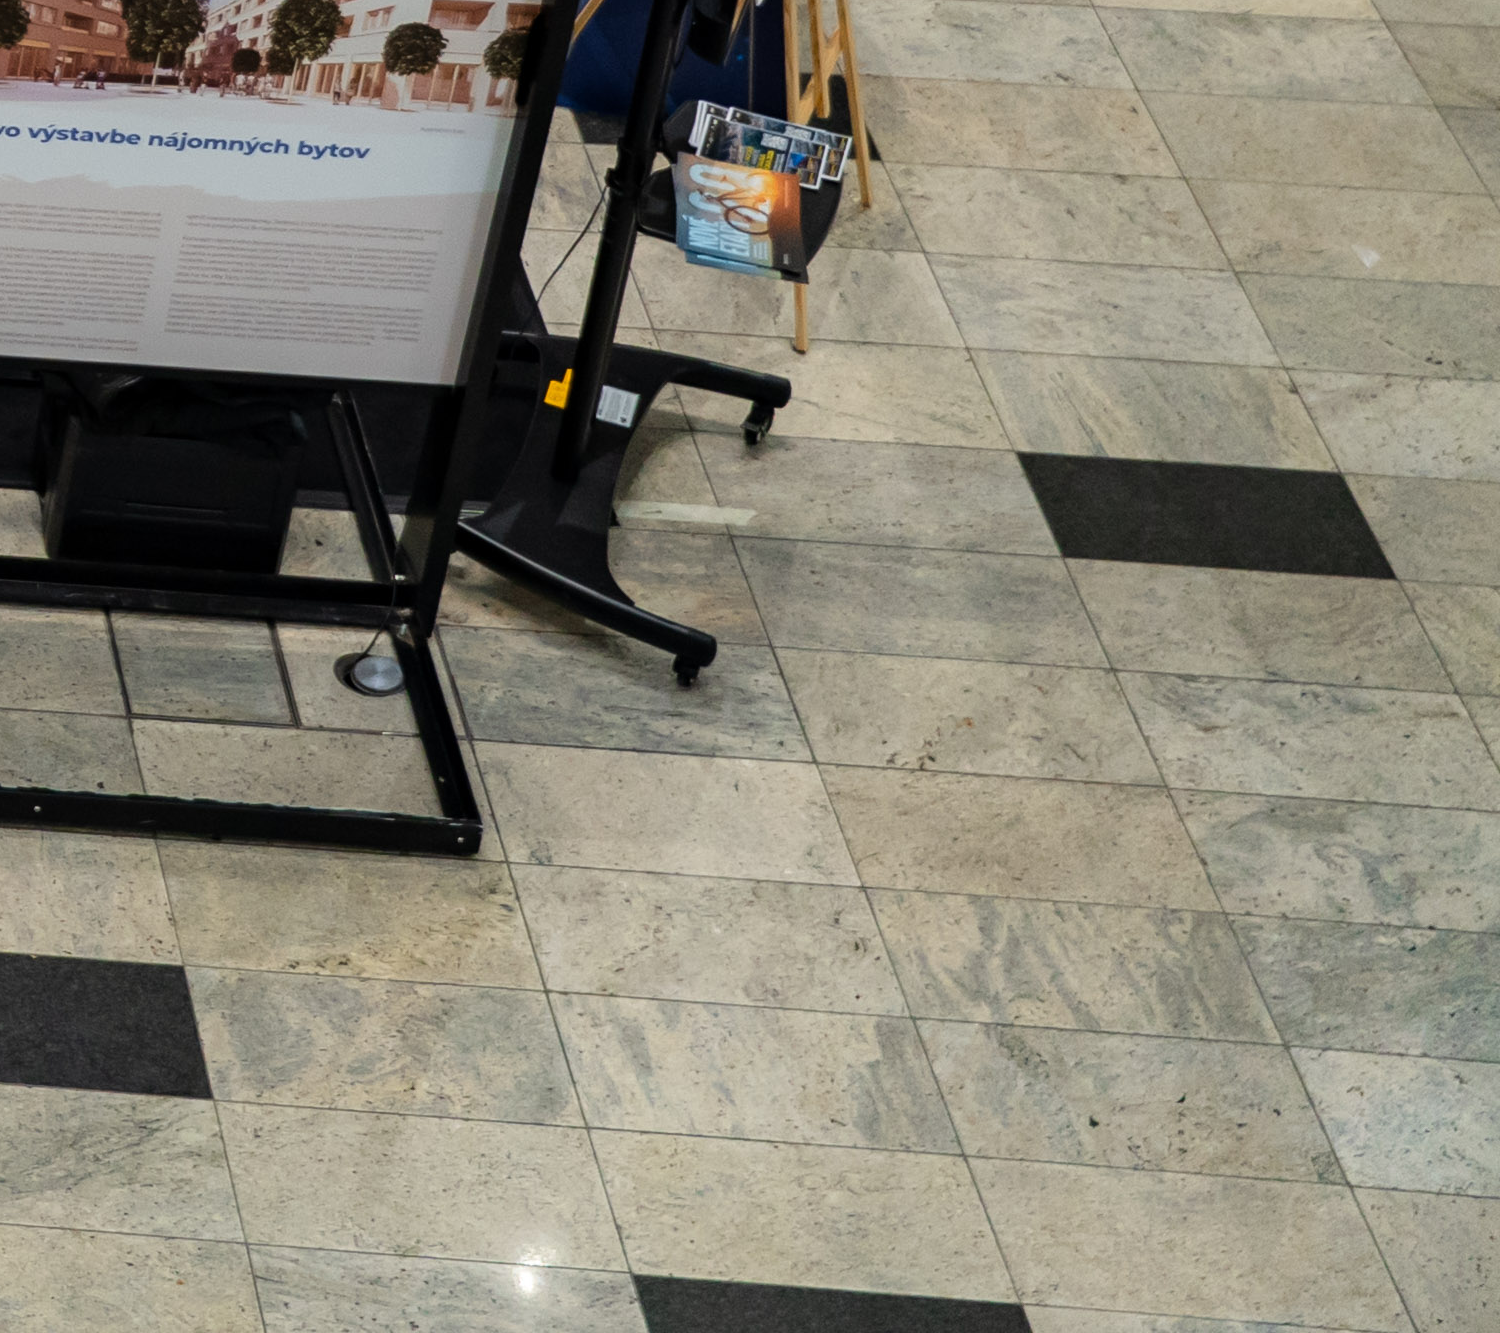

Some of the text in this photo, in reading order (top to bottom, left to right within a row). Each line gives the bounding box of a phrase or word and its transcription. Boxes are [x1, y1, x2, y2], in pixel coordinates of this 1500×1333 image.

[28, 124, 141, 145] výstavbe
[148, 130, 290, 155] nájomných
[297, 140, 371, 160] bytov
